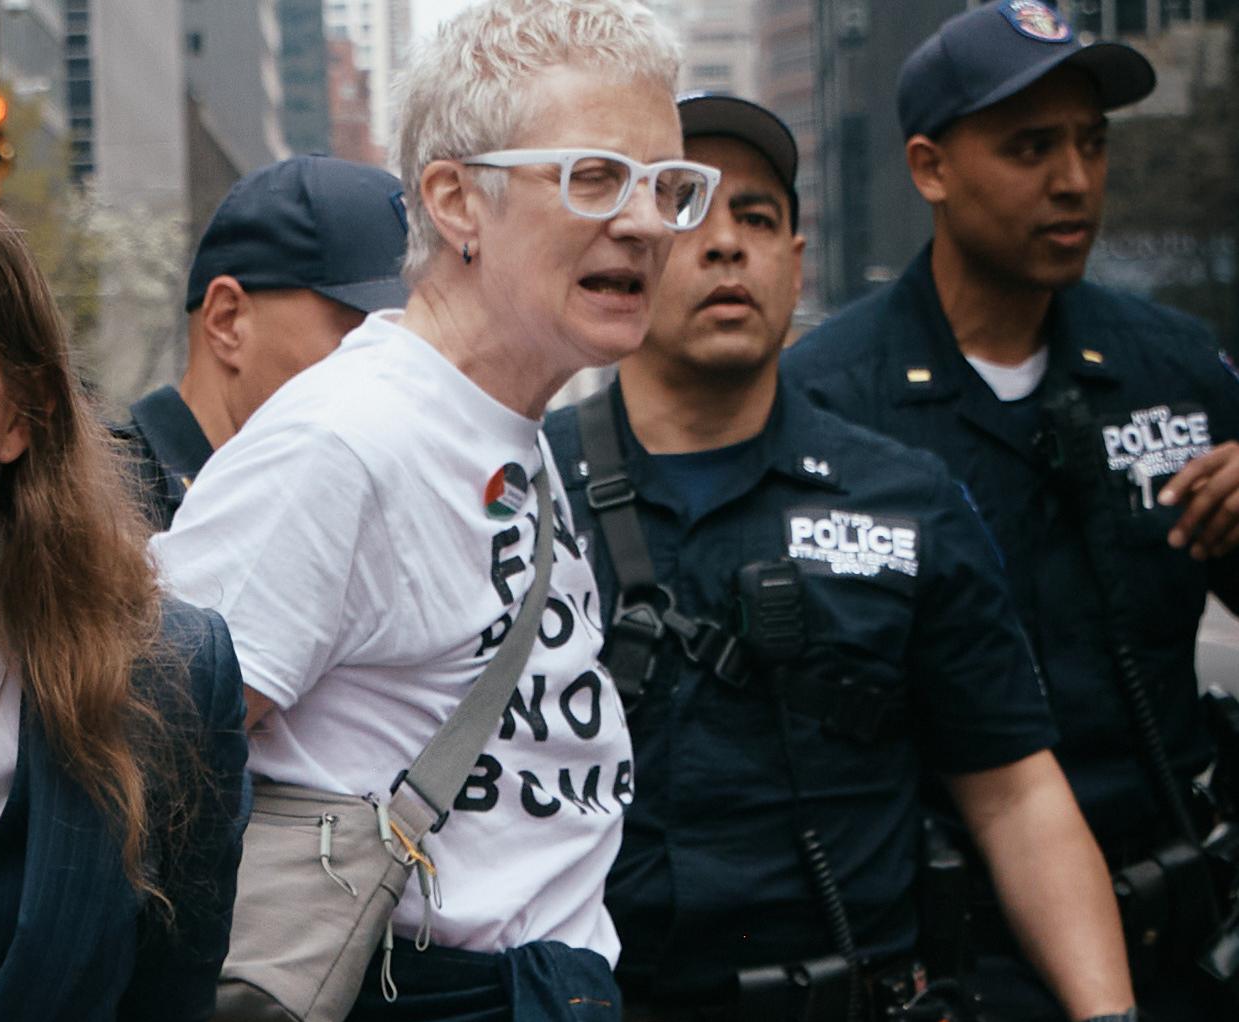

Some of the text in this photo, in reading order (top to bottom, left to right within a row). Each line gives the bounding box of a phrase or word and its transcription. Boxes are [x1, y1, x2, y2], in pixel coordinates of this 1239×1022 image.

[1102, 411, 1210, 457] POLICE
[790, 517, 916, 560] POLICE
[498, 669, 625, 740] NO
